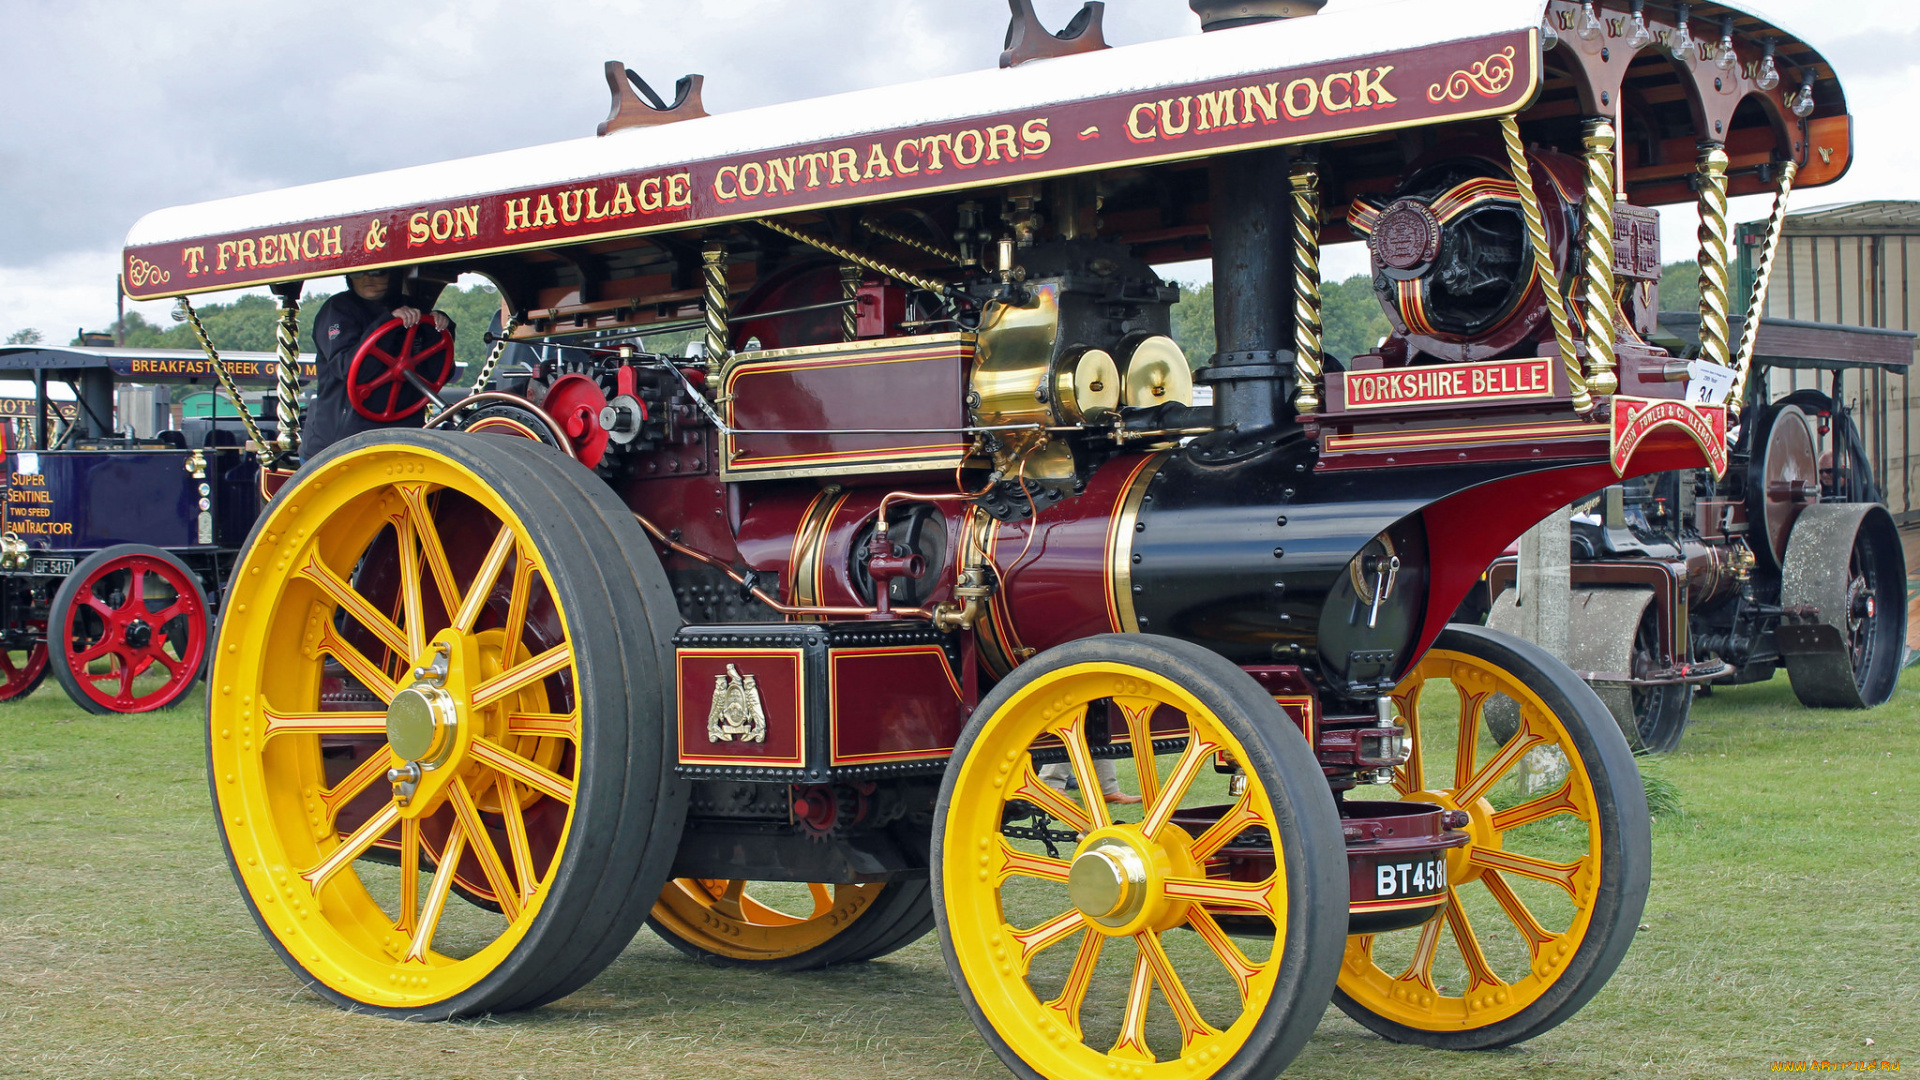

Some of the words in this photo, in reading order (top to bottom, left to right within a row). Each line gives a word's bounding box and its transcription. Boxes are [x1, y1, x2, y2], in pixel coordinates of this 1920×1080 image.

[183, 245, 209, 278] T.
[215, 225, 344, 274] FRENCH
[364, 218, 388, 253] &
[407, 204, 480, 248] SON
[503, 172, 692, 233] HAULAGE
[713, 118, 1053, 203] CONTRACTORS
[1123, 65, 1398, 143] CUMNOCK
[131, 359, 211, 374] BREAKFAST
[222, 361, 260, 375] REEK
[1351, 370, 1467, 402] YORKSHIRE
[1472, 365, 1546, 394] BELLE
[1620, 428, 1637, 458] JOHN
[1639, 405, 1666, 431] FOWLER
[1668, 405, 1675, 418] &
[11, 472, 46, 487] SUPER
[7, 488, 54, 504] SENTINEL
[10, 507, 27, 517] TWO
[28, 507, 51, 518] SPEED
[50, 561, 73, 575] 5417
